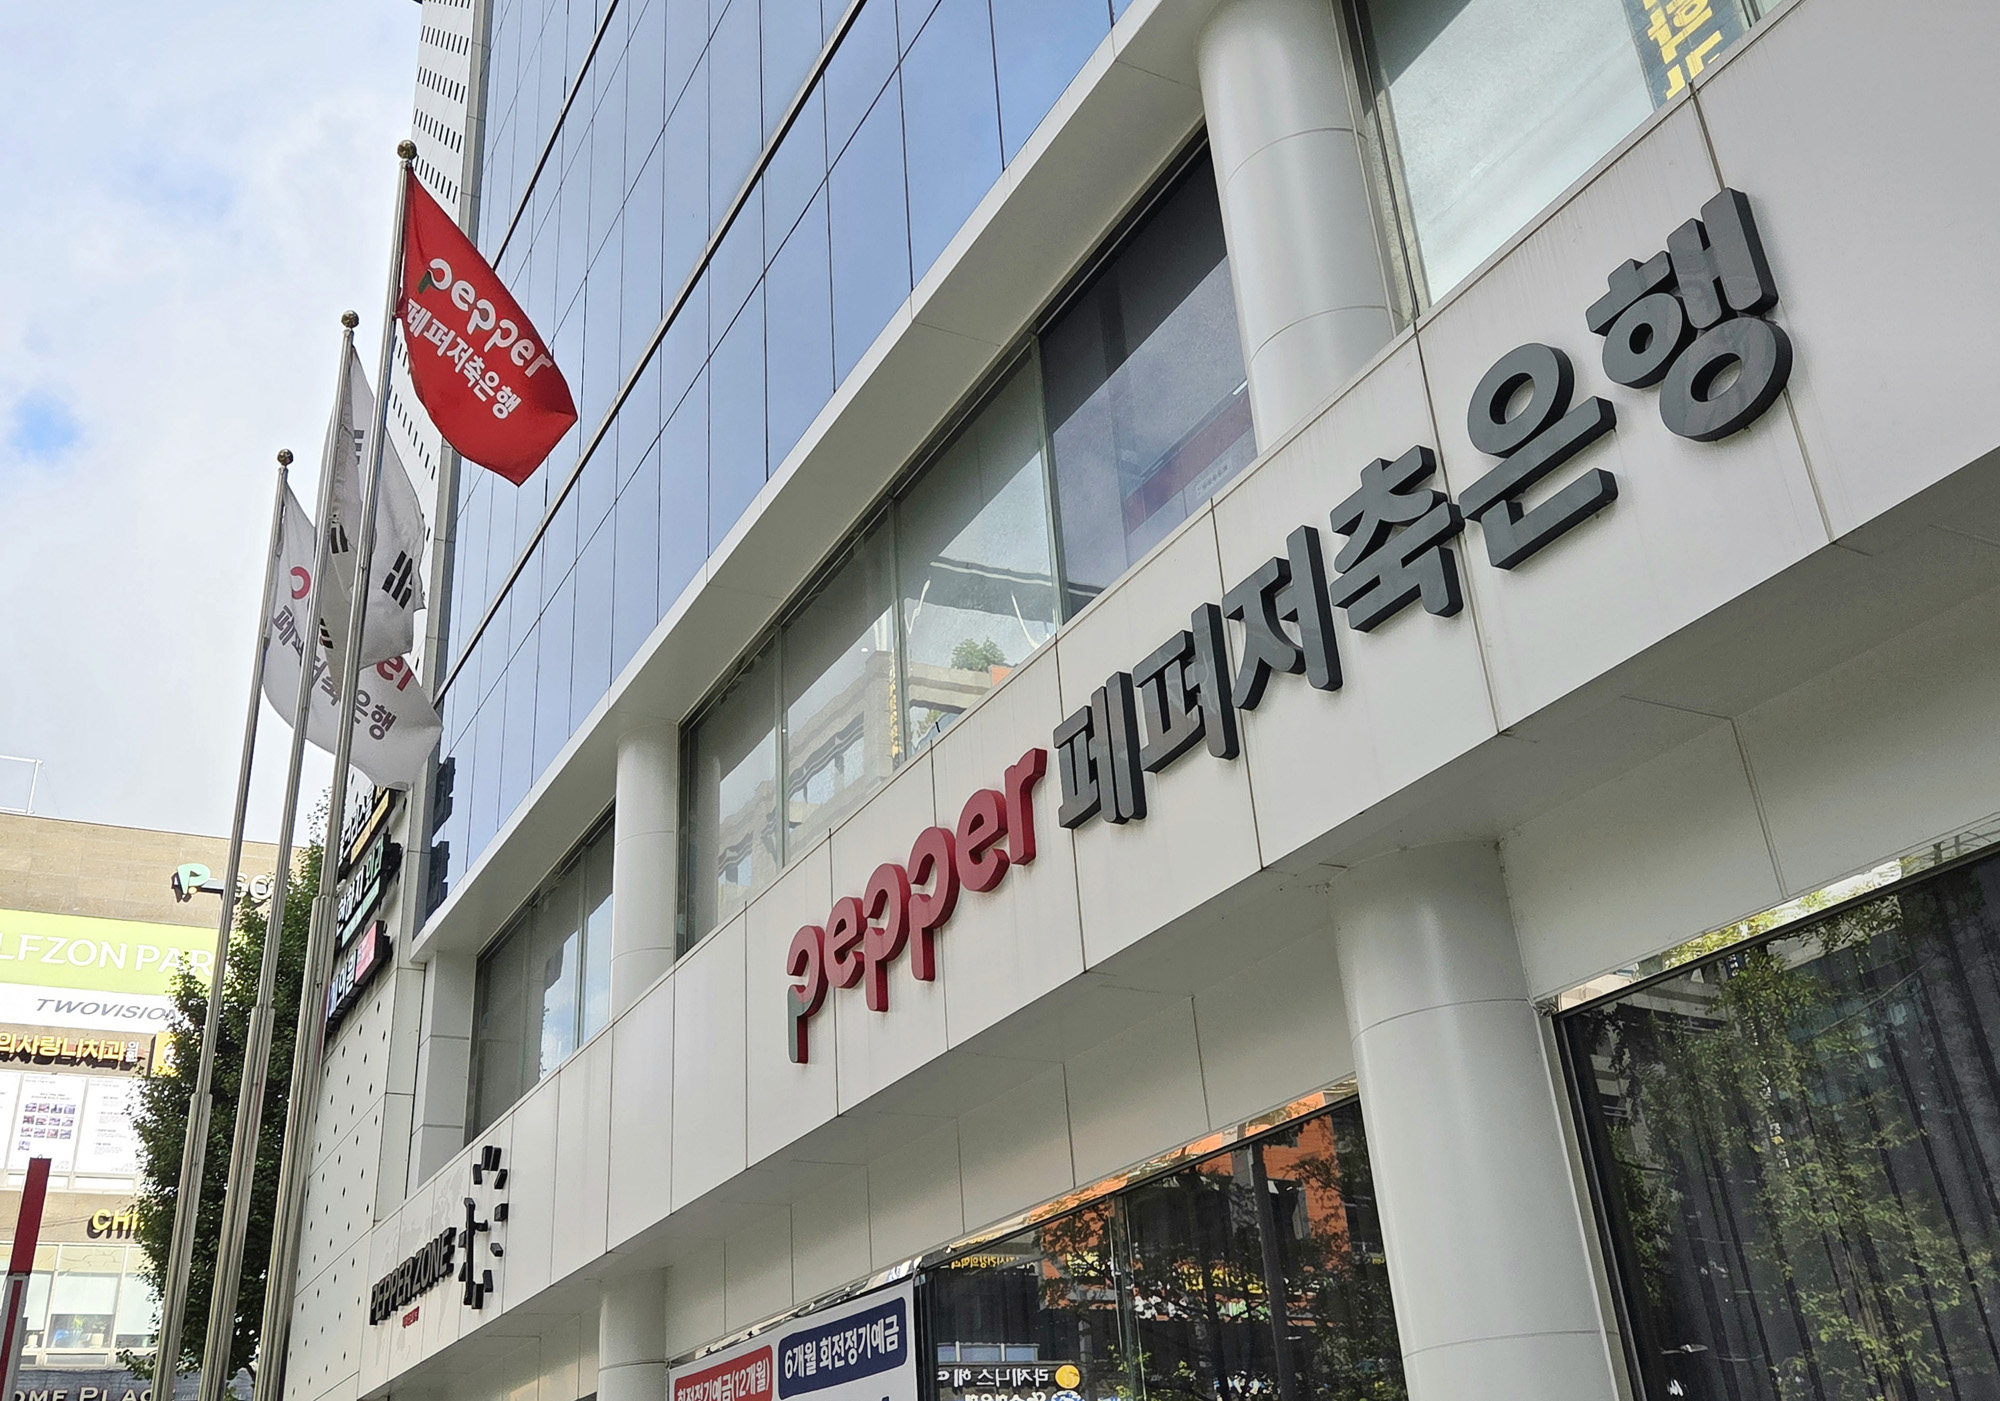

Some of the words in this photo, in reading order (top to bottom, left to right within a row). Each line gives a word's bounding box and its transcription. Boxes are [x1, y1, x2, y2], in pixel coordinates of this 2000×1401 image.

[404, 298, 522, 419] 페퍼저축은행
[417, 257, 552, 377] pepper
[786, 747, 1048, 1064] pepper
[1053, 187, 1794, 829] 페퍼저축은행
[369, 1255, 415, 1325] PEPPER
[412, 1226, 457, 1296] ZONE
[784, 1339, 818, 1380] 6개월
[819, 1313, 900, 1372] 회전정기예금
